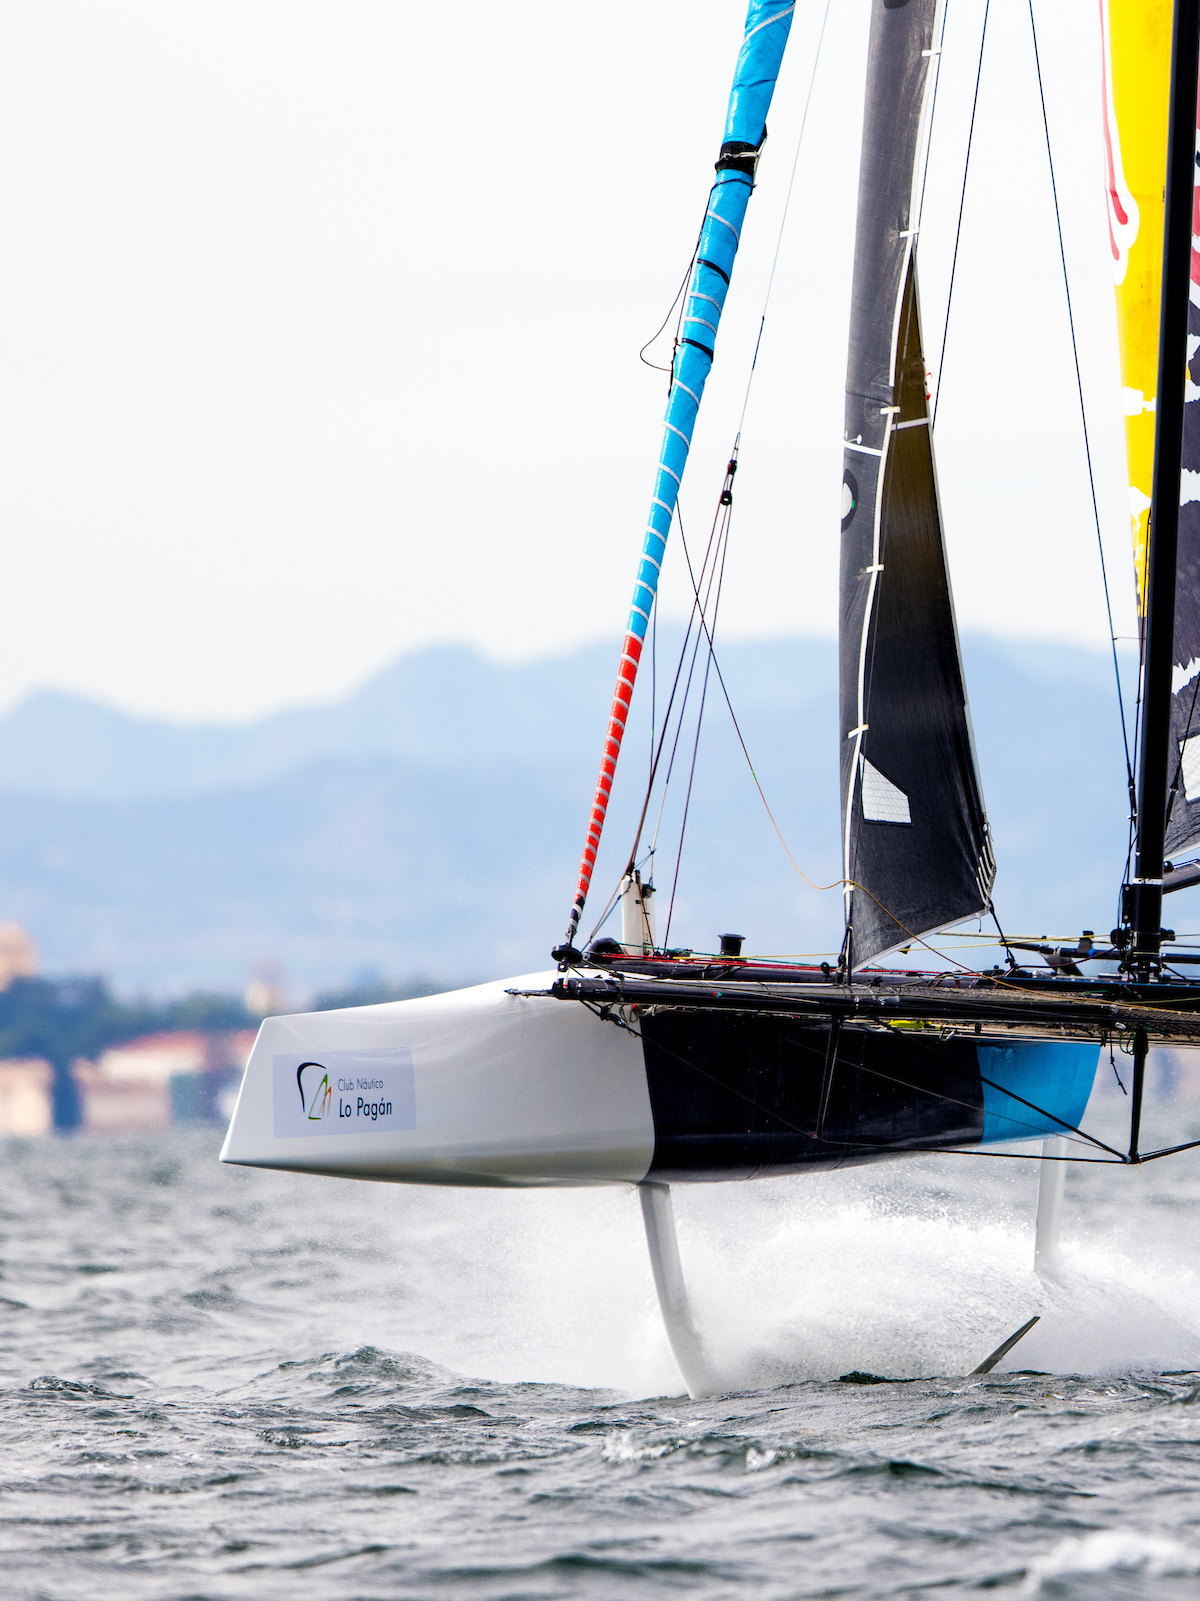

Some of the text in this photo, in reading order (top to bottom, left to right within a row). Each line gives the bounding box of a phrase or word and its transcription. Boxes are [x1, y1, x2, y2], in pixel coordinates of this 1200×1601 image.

[338, 1078, 384, 1091] Club Náutico
[340, 1097, 392, 1121] Lo Pagán
